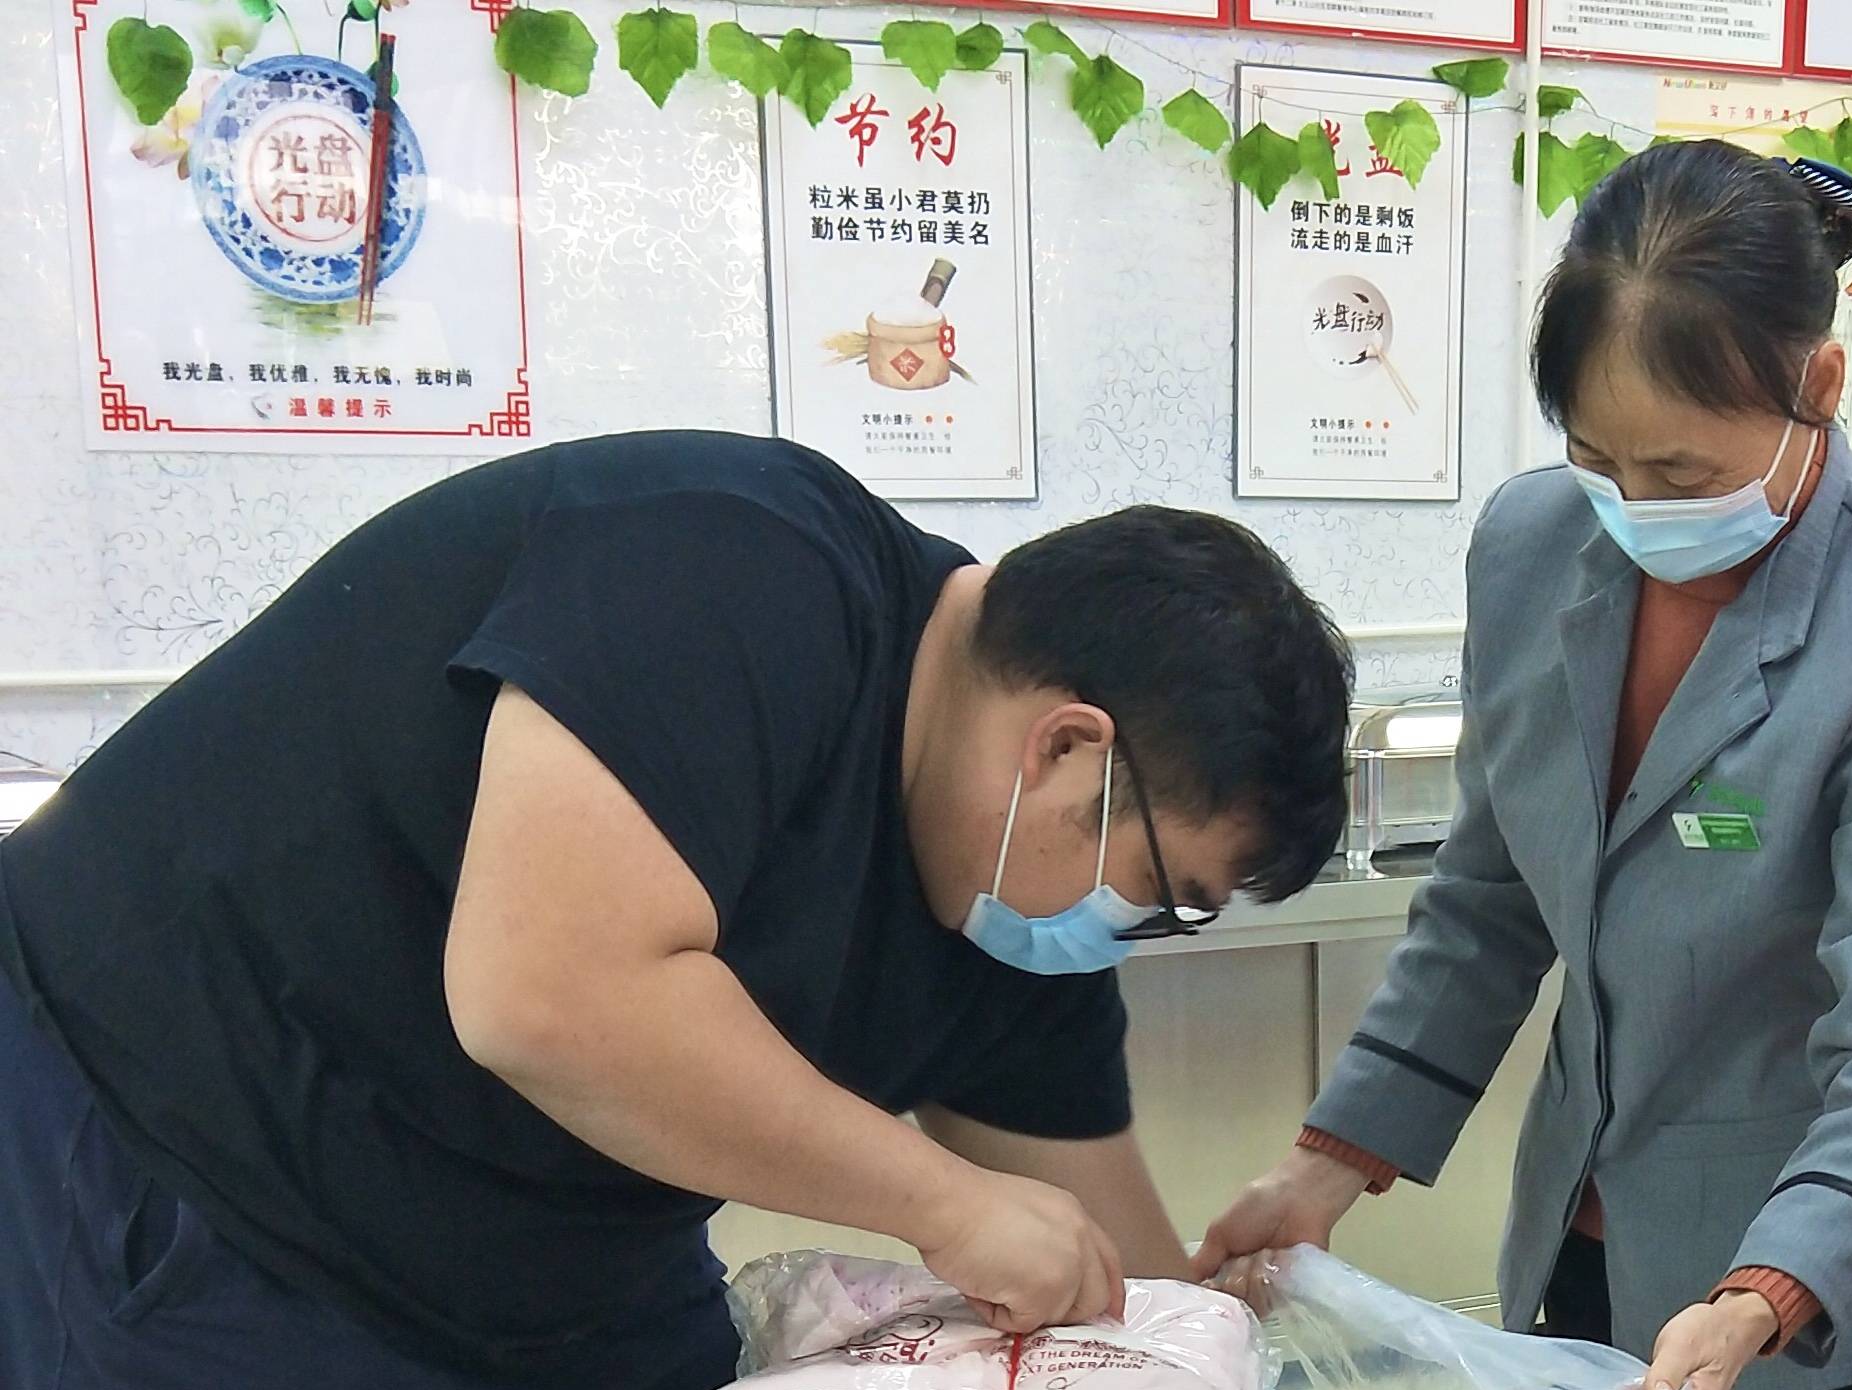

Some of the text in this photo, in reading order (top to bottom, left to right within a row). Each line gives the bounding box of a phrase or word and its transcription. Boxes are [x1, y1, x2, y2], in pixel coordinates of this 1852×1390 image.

[835, 93, 956, 168] 节约
[268, 131, 354, 178] 光盘
[271, 179, 356, 224] 行动
[808, 185, 990, 215] 粒米虽小君莫扔
[1291, 201, 1415, 228] 倒下的是剩饭
[811, 217, 990, 245] 勤俭节约留美名
[1291, 228, 1415, 255] 流走的是血汗
[1312, 302, 1384, 332] 光盘行动
[289, 397, 393, 419] 温馨提示
[1047, 1360, 1144, 1373] GENERATION
